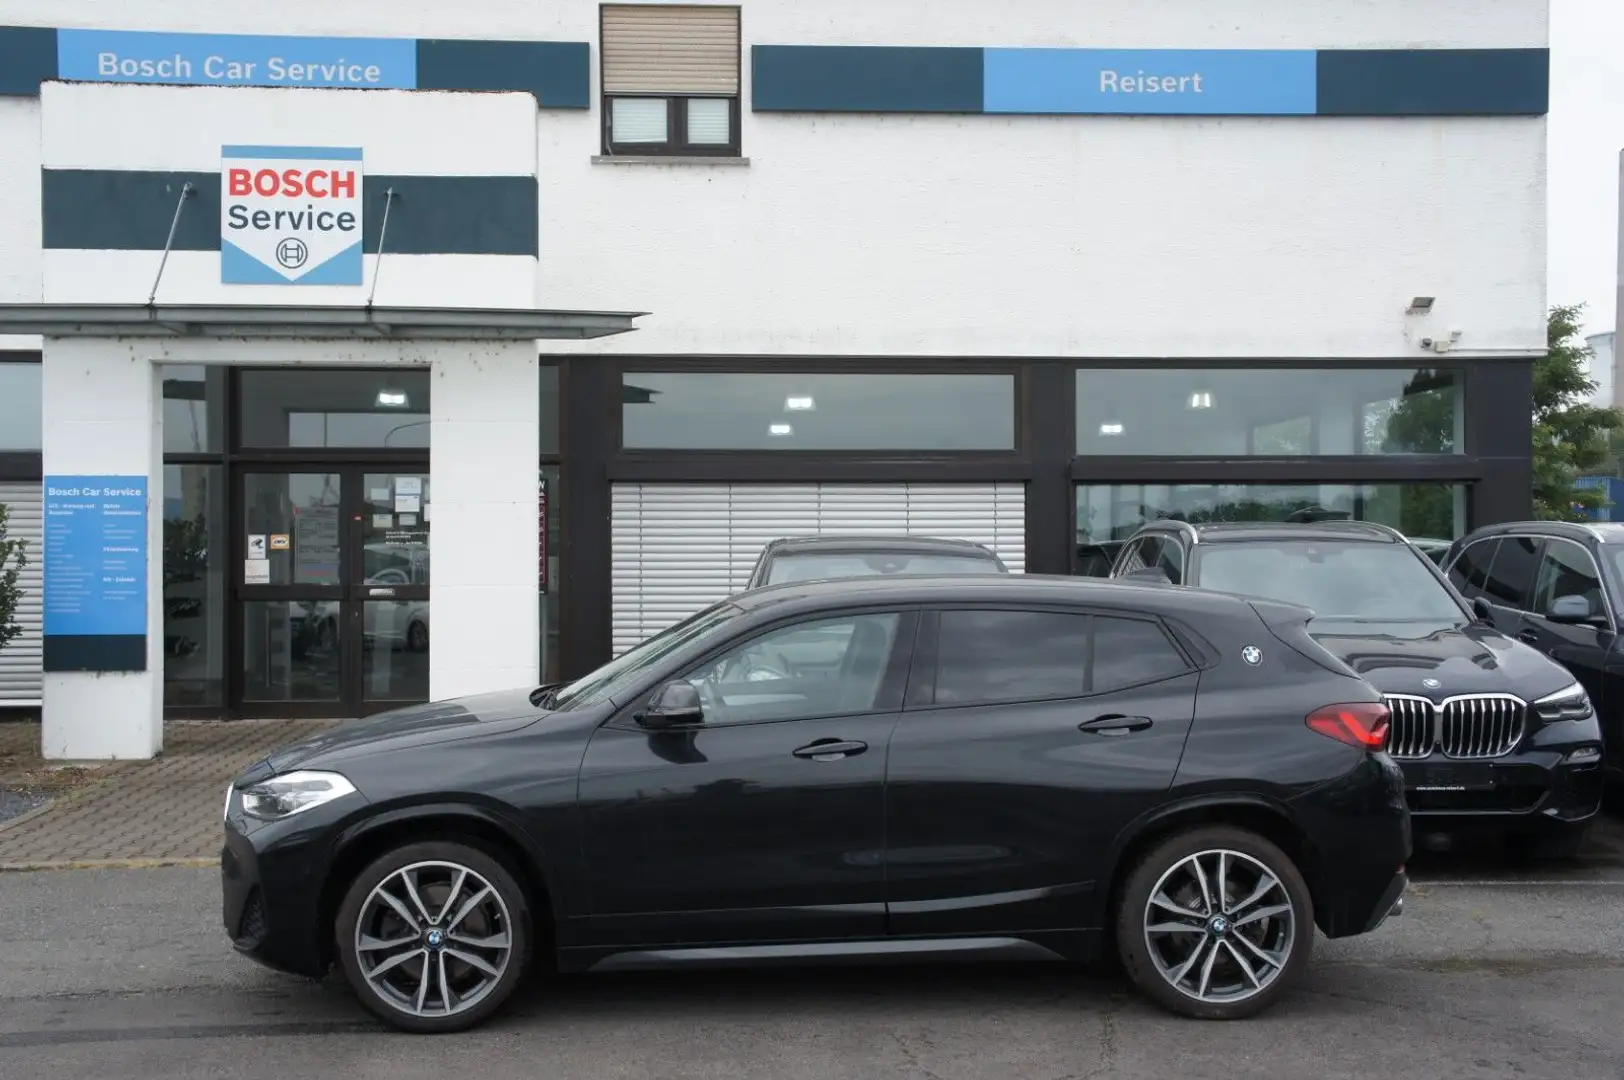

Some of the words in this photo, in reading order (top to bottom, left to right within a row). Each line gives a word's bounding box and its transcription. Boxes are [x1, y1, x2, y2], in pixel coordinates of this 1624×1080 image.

[98, 52, 192, 78] Bosch
[204, 55, 257, 80] Car
[267, 57, 381, 83] Service
[1099, 69, 1203, 93] Reisert
[228, 168, 356, 198] BOSCH
[227, 204, 356, 232] Service
[48, 487, 80, 496] Bosch
[82, 487, 101, 496] Car
[103, 487, 142, 496] Service
